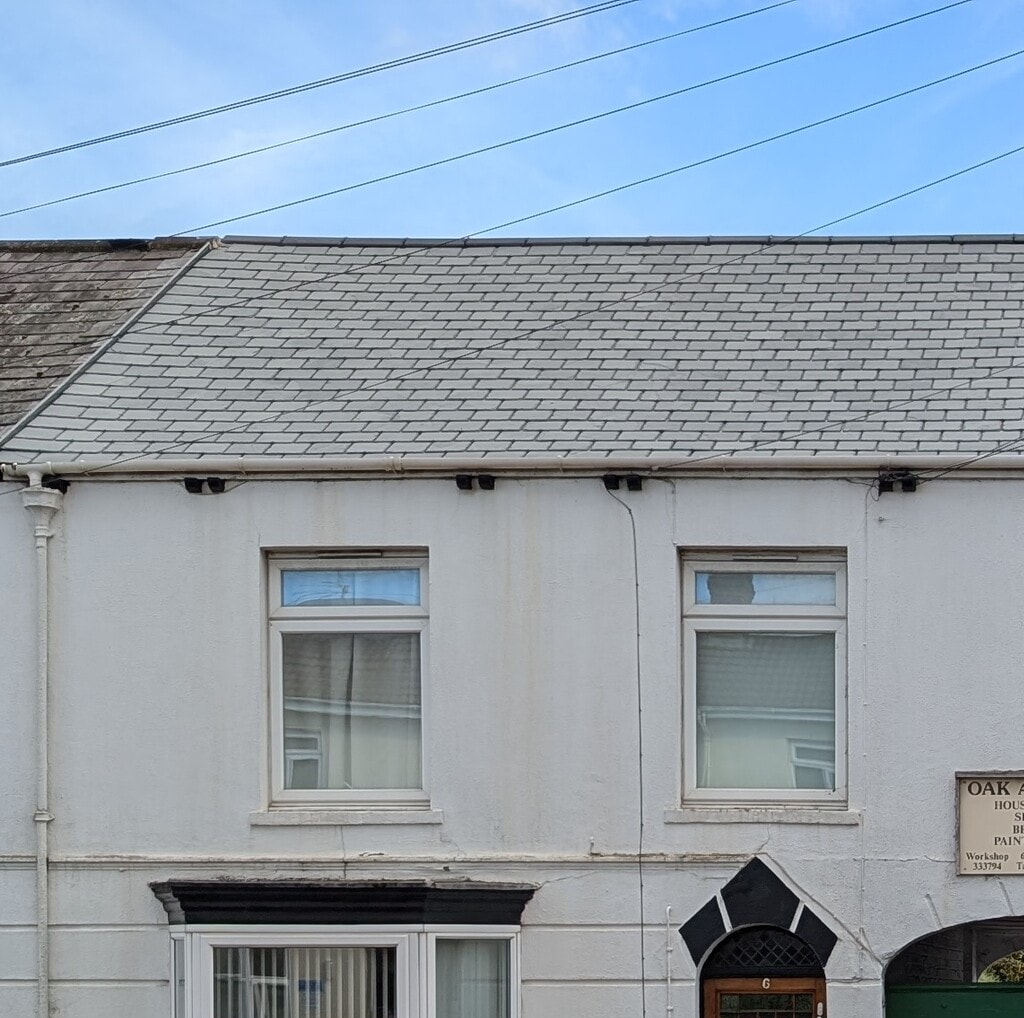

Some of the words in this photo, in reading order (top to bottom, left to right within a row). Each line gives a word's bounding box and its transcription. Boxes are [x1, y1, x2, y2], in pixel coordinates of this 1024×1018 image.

[967, 781, 1010, 796] OAK
[966, 852, 1009, 861] Workshop
[972, 862, 1002, 871] 333794
[761, 977, 771, 989] 6
